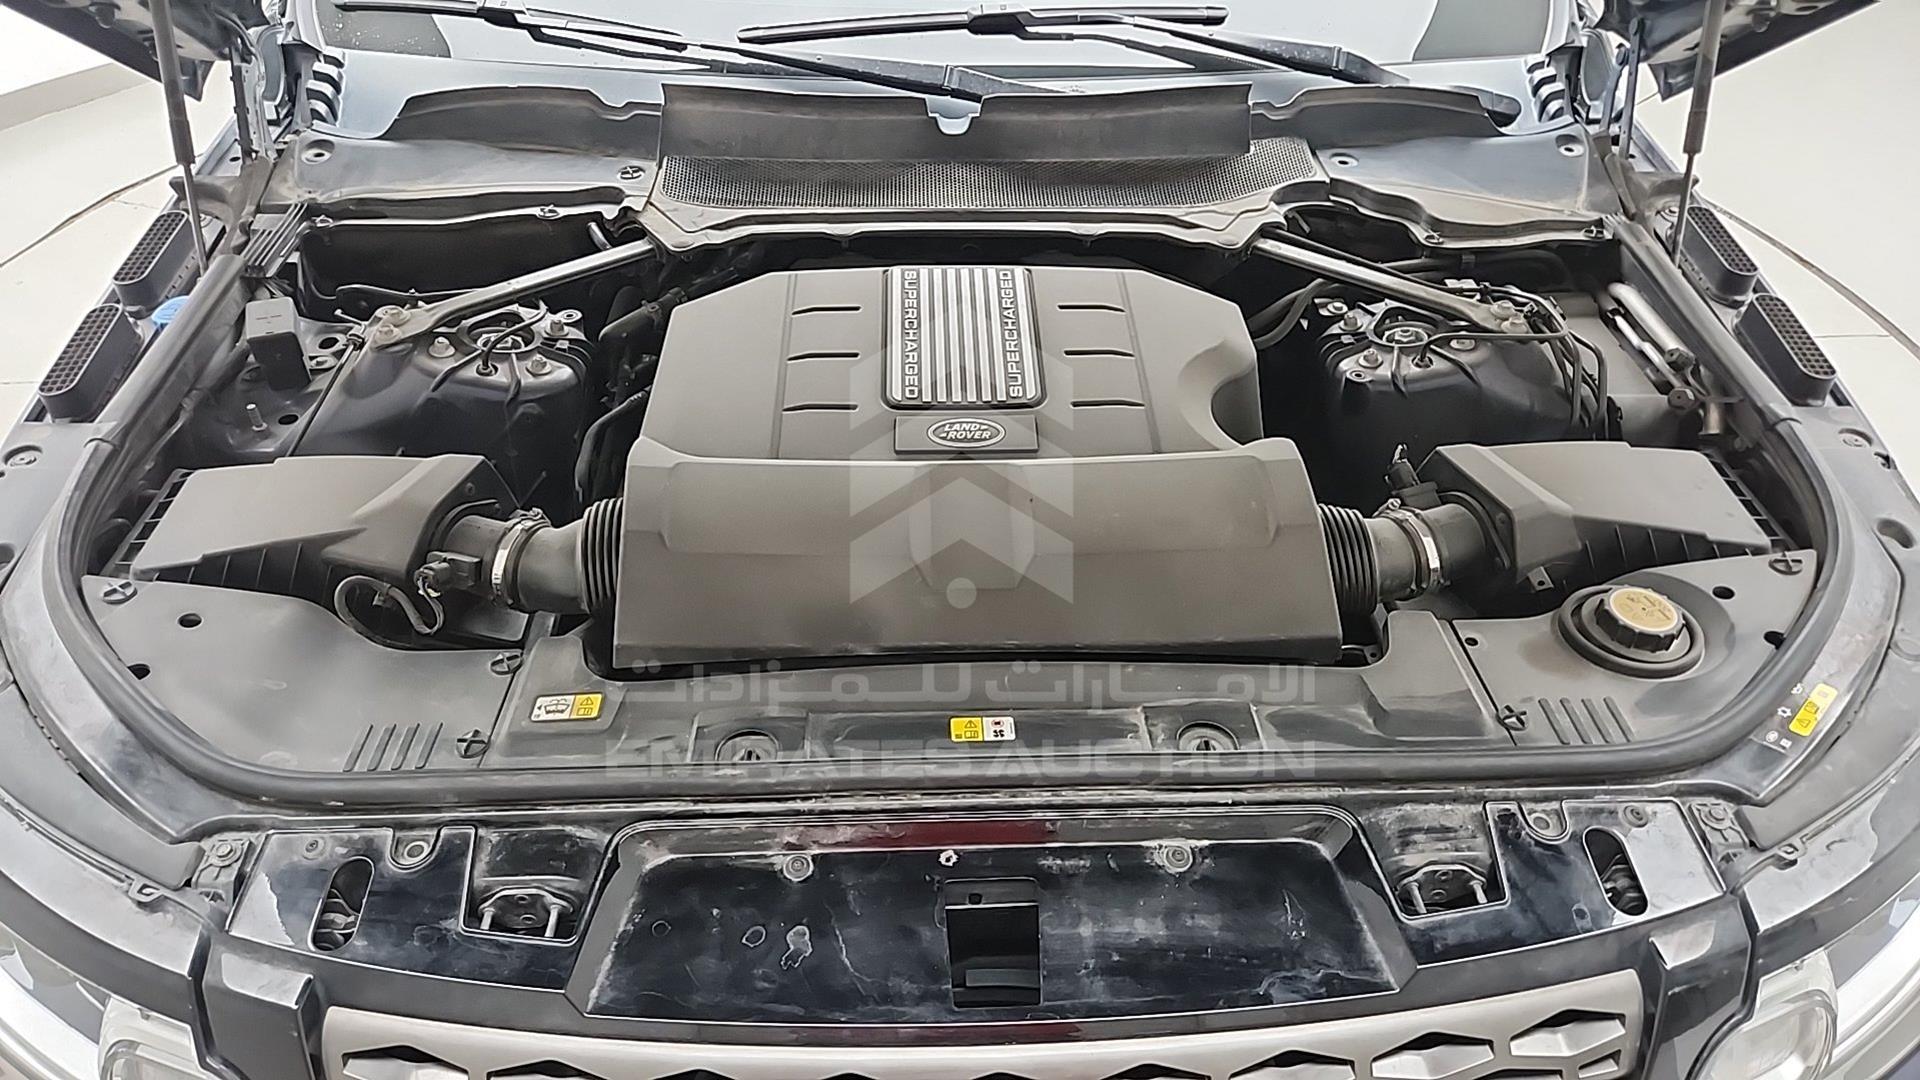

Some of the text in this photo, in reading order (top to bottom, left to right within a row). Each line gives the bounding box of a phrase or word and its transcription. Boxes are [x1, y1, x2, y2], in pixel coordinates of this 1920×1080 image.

[904, 270, 919, 399] SUPERCHARGED
[999, 270, 1023, 398] SUPERCHARGED
[944, 423, 980, 431] LAND
[946, 431, 991, 439] ROVER
